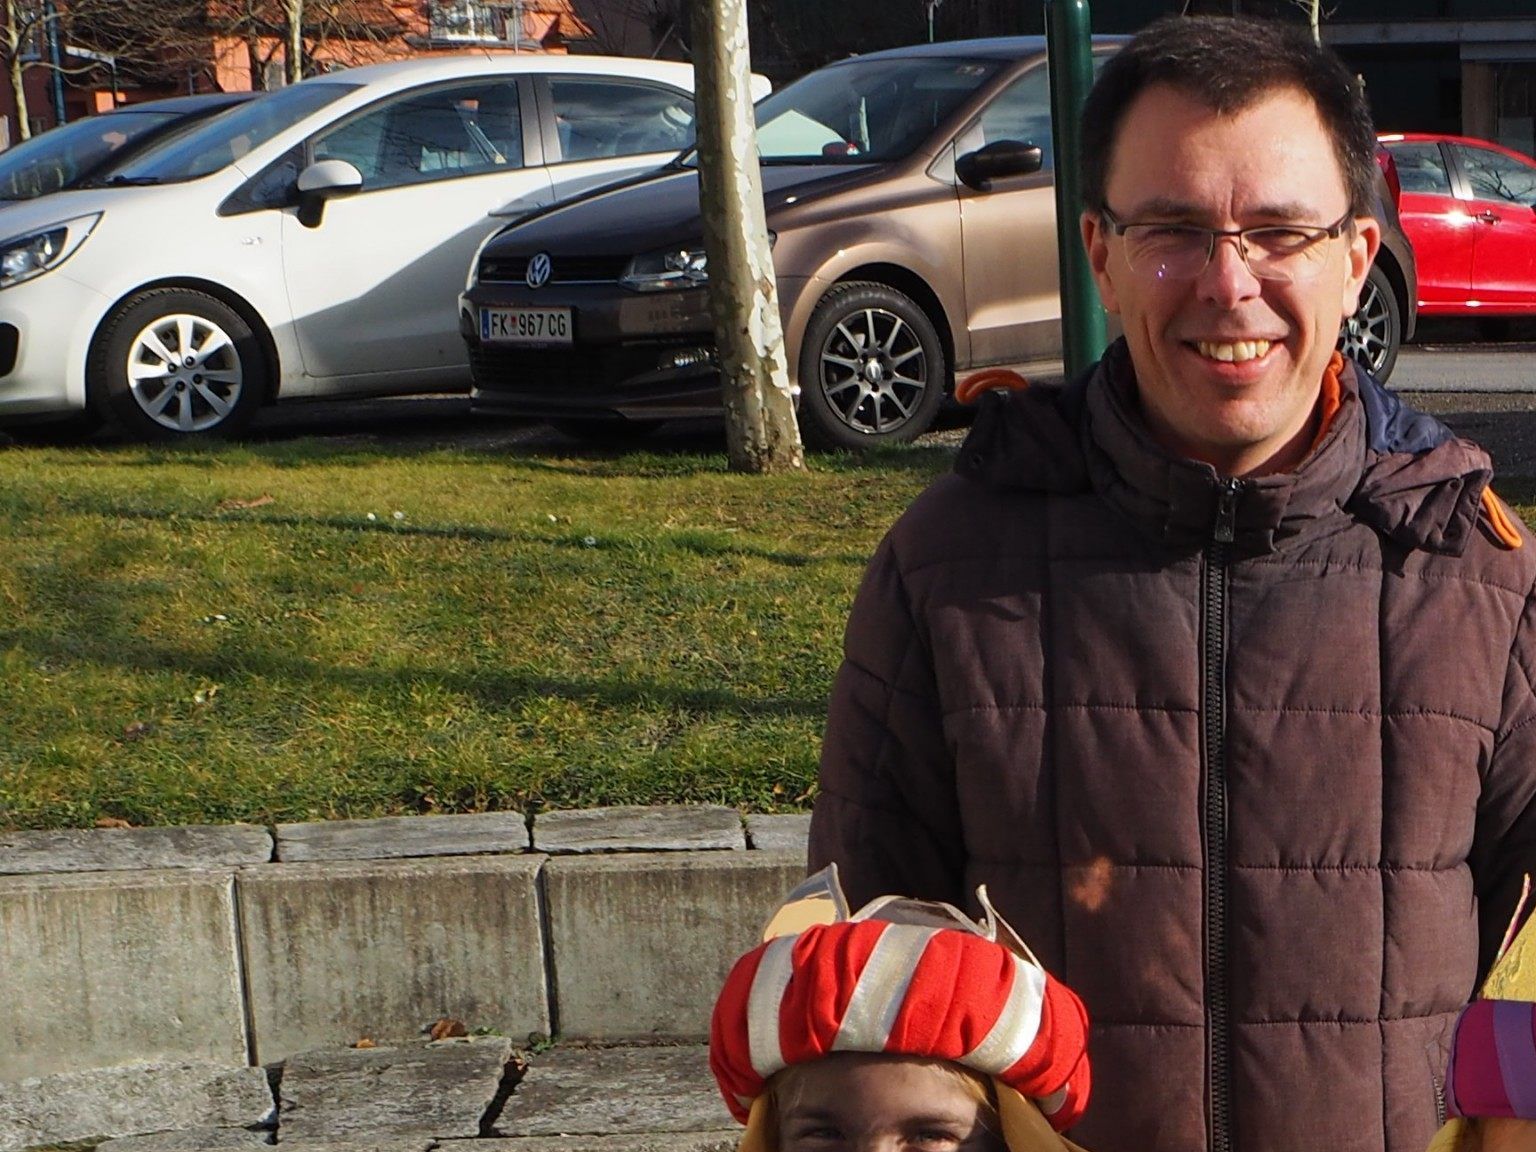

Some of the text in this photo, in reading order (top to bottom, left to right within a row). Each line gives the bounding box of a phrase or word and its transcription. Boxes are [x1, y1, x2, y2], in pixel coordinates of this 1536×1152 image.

[491, 313, 566, 337] FK 967 CG
